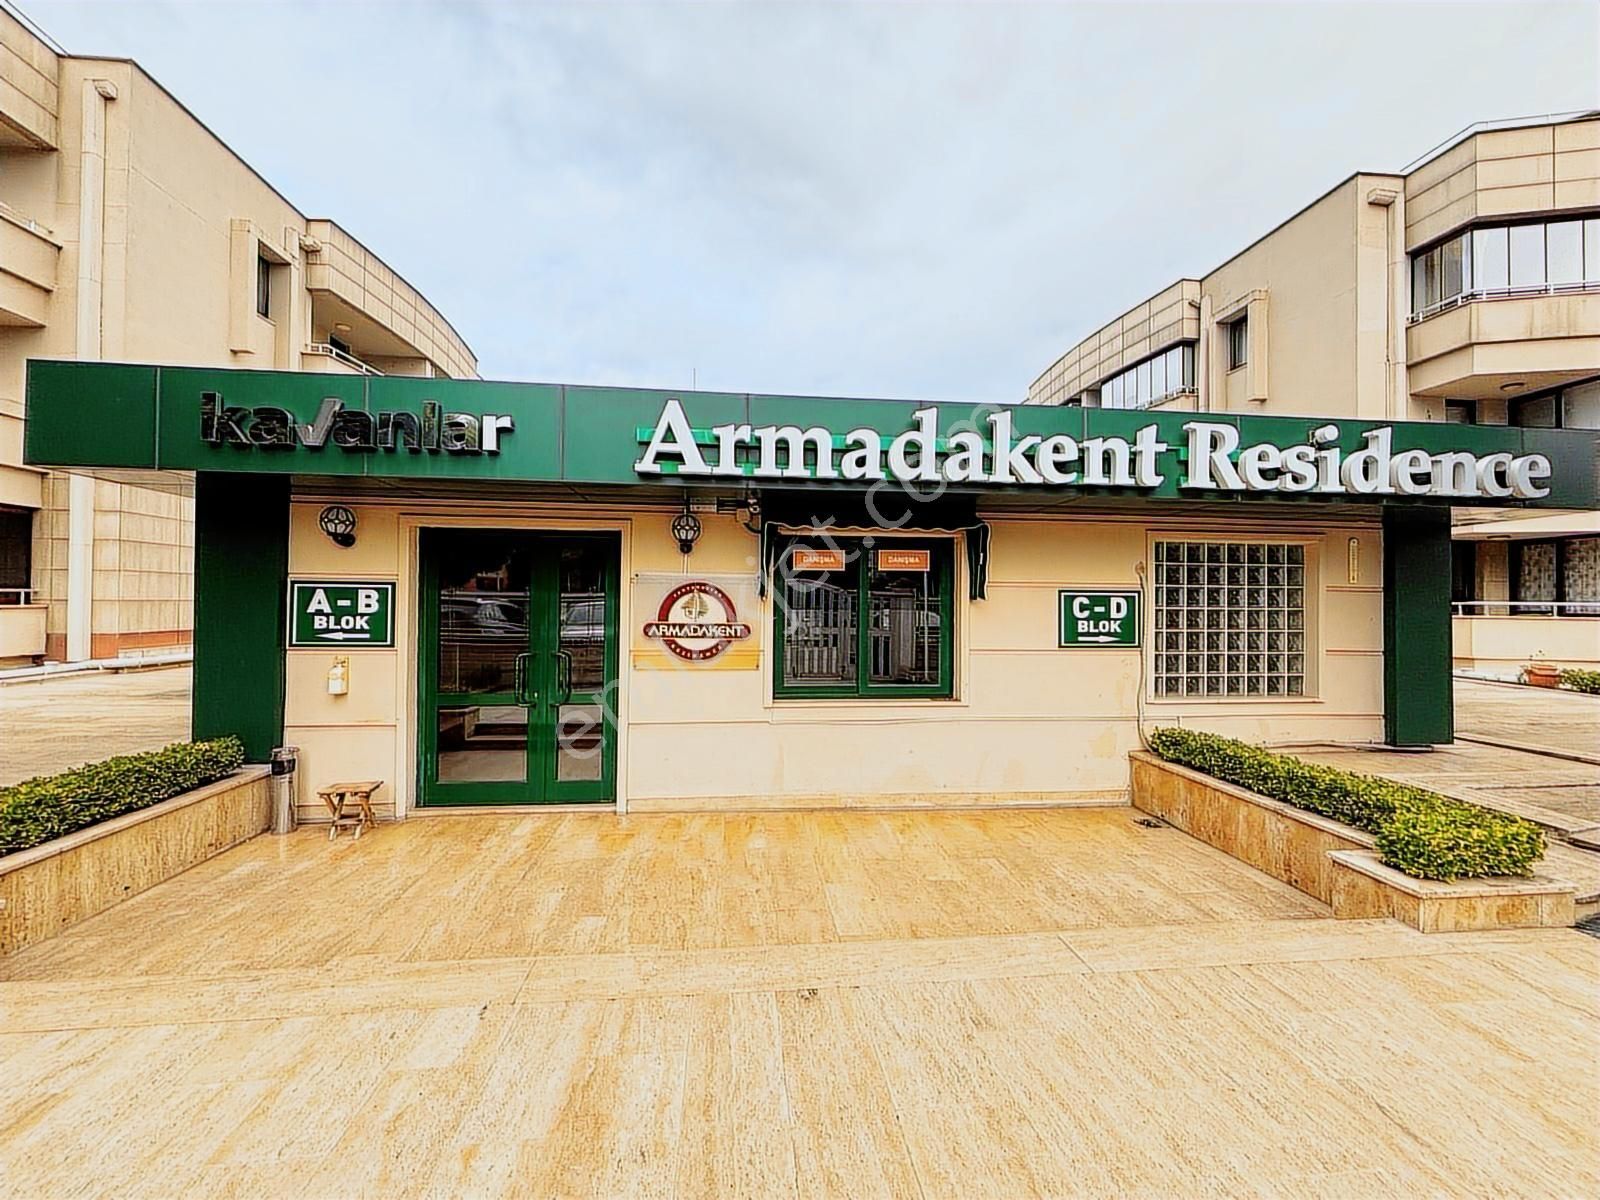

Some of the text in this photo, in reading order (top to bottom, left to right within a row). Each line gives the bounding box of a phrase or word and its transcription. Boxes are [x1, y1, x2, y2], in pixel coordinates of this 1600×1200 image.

[634, 399, 1552, 498] Armadakent Residence
[313, 615, 370, 630] BLOK
[1077, 620, 1122, 633] BLOK
[648, 625, 745, 637] ARMADAKENT
